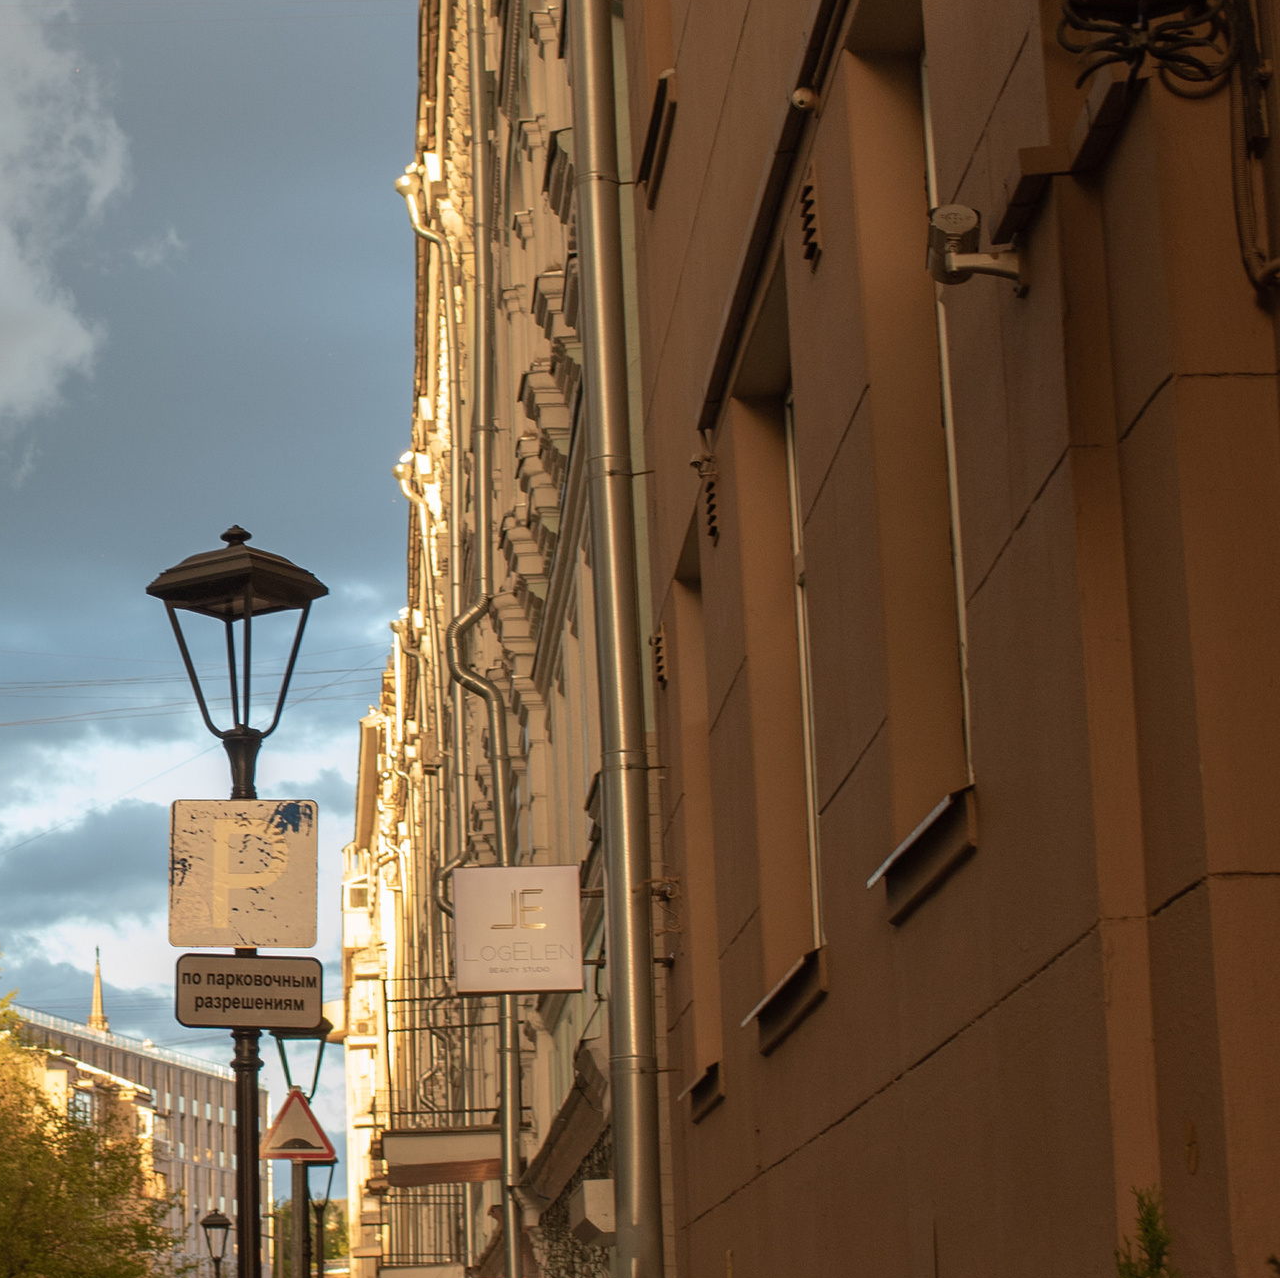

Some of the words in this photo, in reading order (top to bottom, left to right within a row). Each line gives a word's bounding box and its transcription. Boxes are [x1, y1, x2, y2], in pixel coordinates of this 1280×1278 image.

[213, 818, 289, 928] P
[182, 972, 202, 985] по
[206, 972, 317, 990] парковочным
[194, 995, 305, 1012] разрешениям
